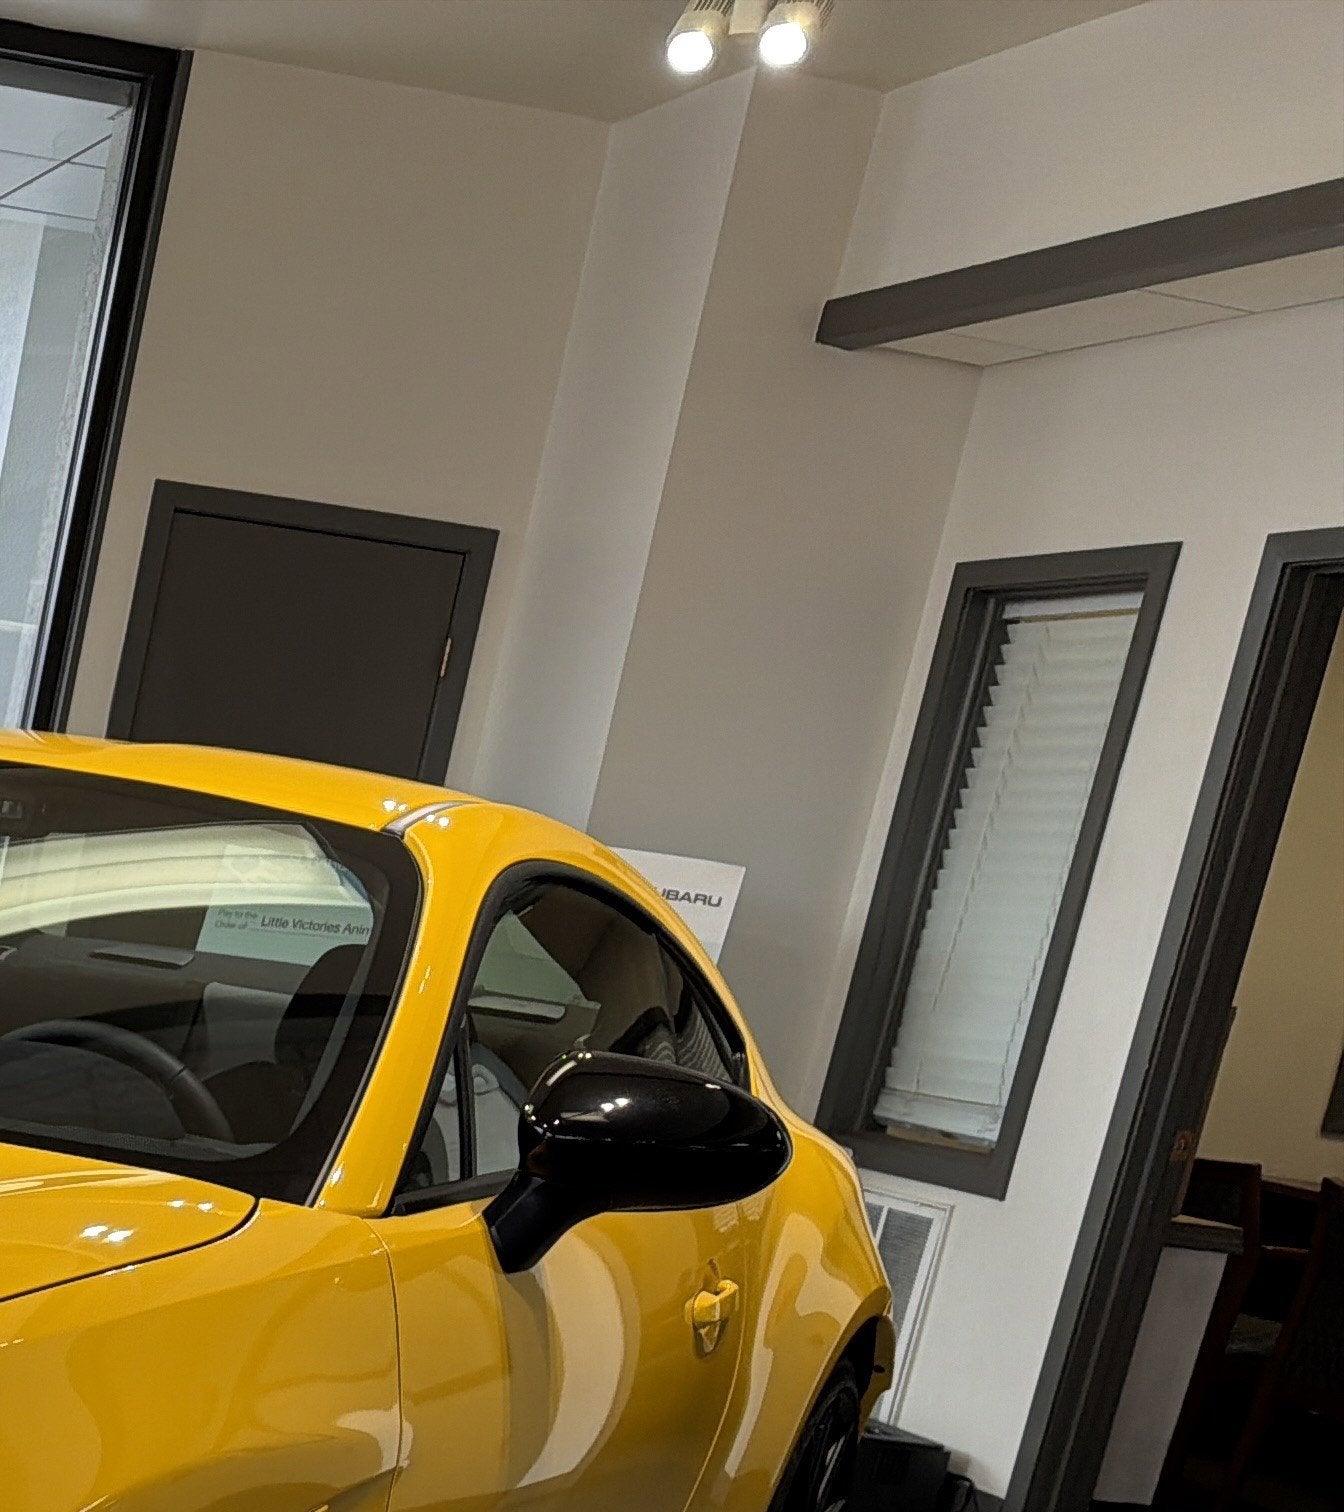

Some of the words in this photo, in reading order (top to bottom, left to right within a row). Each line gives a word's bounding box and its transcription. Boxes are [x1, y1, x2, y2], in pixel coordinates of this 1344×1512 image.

[661, 887, 723, 908] BARU
[260, 914, 289, 929] Little
[292, 918, 340, 934] Victories
